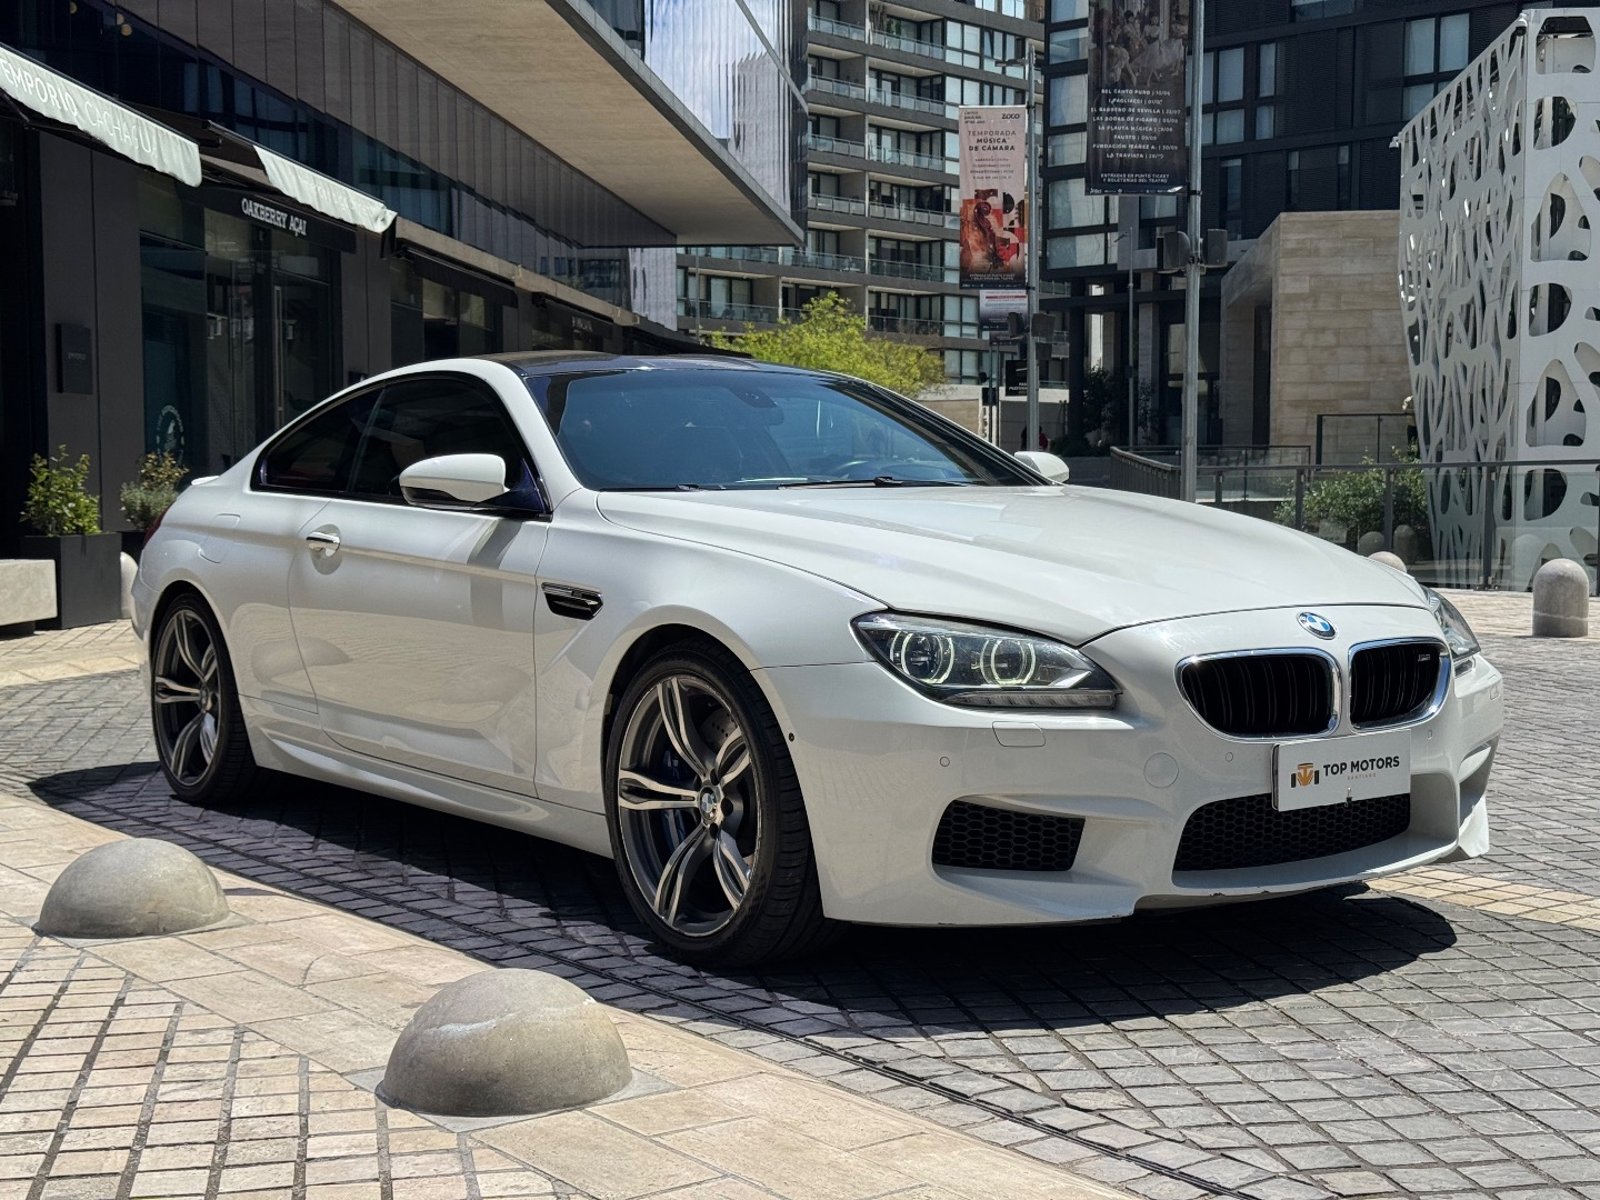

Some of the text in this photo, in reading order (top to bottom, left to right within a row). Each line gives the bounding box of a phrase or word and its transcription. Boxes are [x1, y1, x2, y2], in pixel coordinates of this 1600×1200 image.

[0, 59, 77, 117] EMPORIO
[241, 198, 288, 229] OAKBERRY
[1323, 755, 1400, 777] TOP MOTORS
